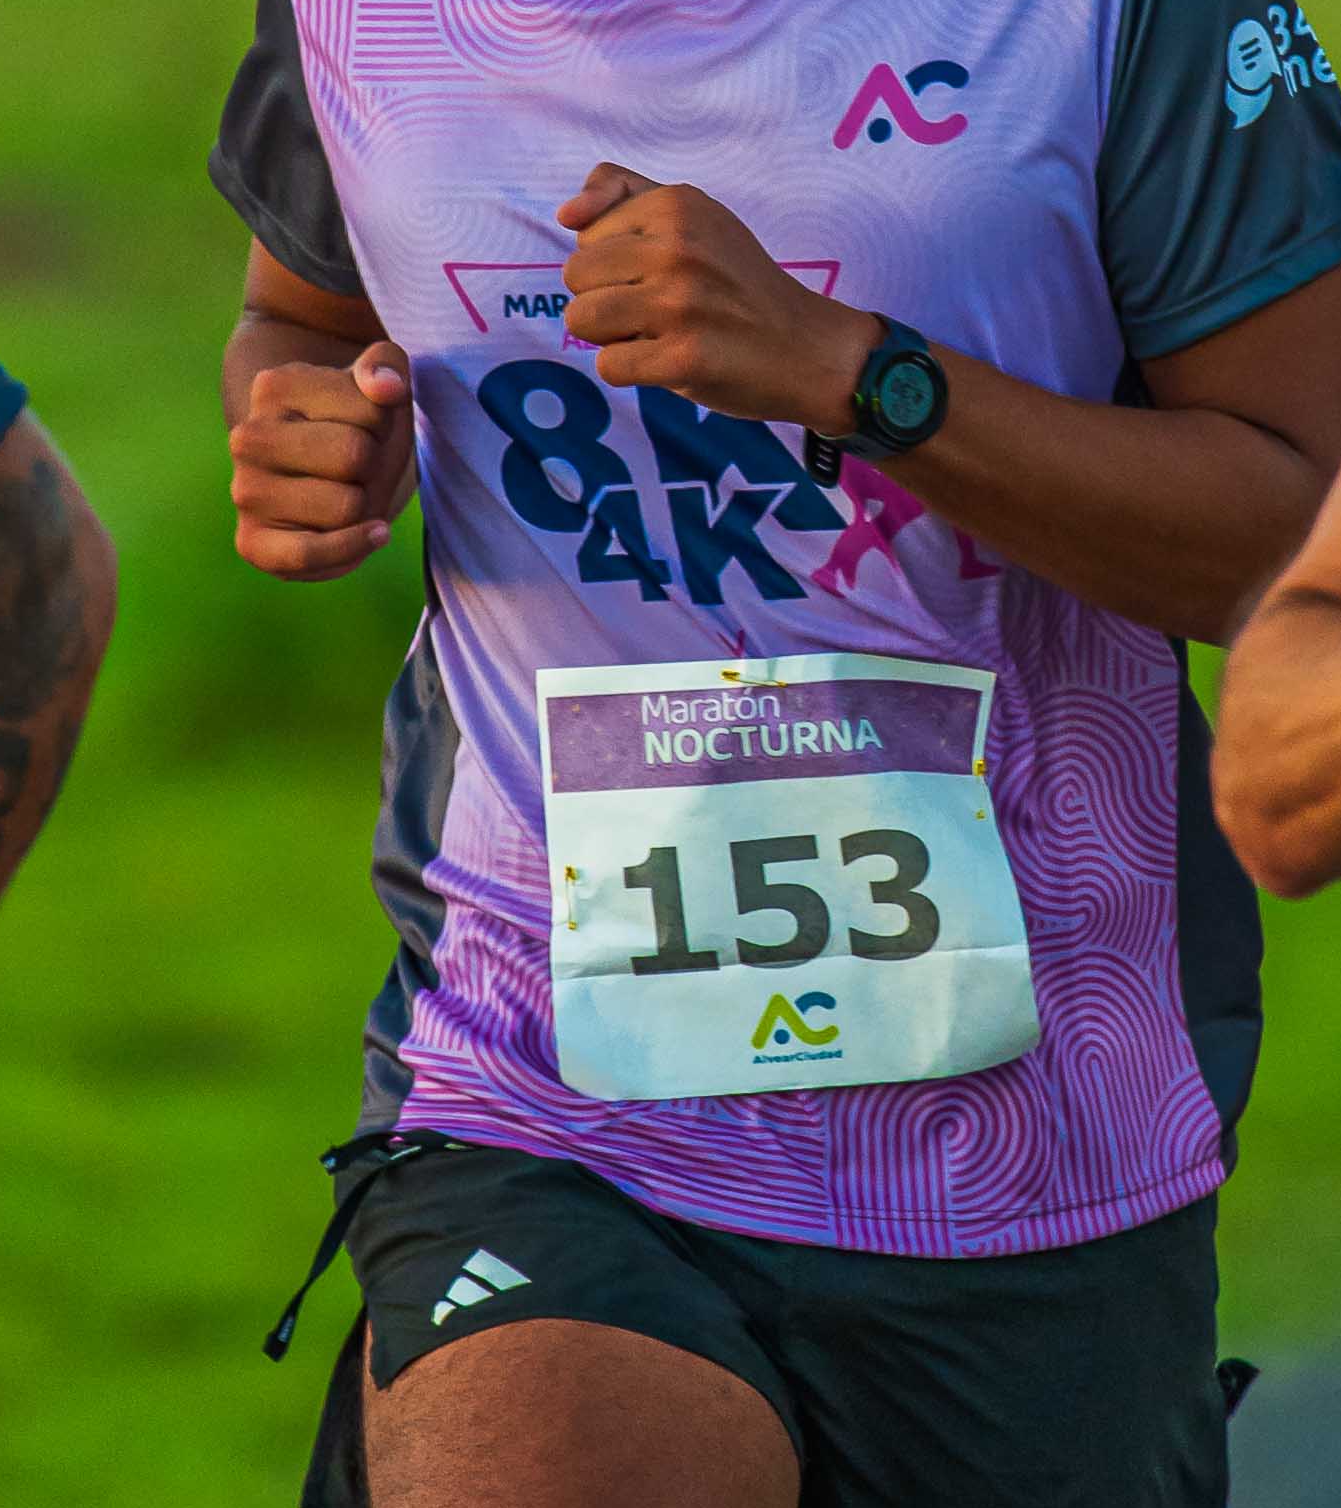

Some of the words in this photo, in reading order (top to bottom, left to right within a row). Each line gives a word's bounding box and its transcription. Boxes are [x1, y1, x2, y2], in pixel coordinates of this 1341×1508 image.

[477, 359, 849, 534] 8K
[576, 487, 810, 606] 4K
[641, 686, 781, 726] Maratón
[644, 716, 884, 766] NOCTURNA
[623, 829, 941, 976] 153
